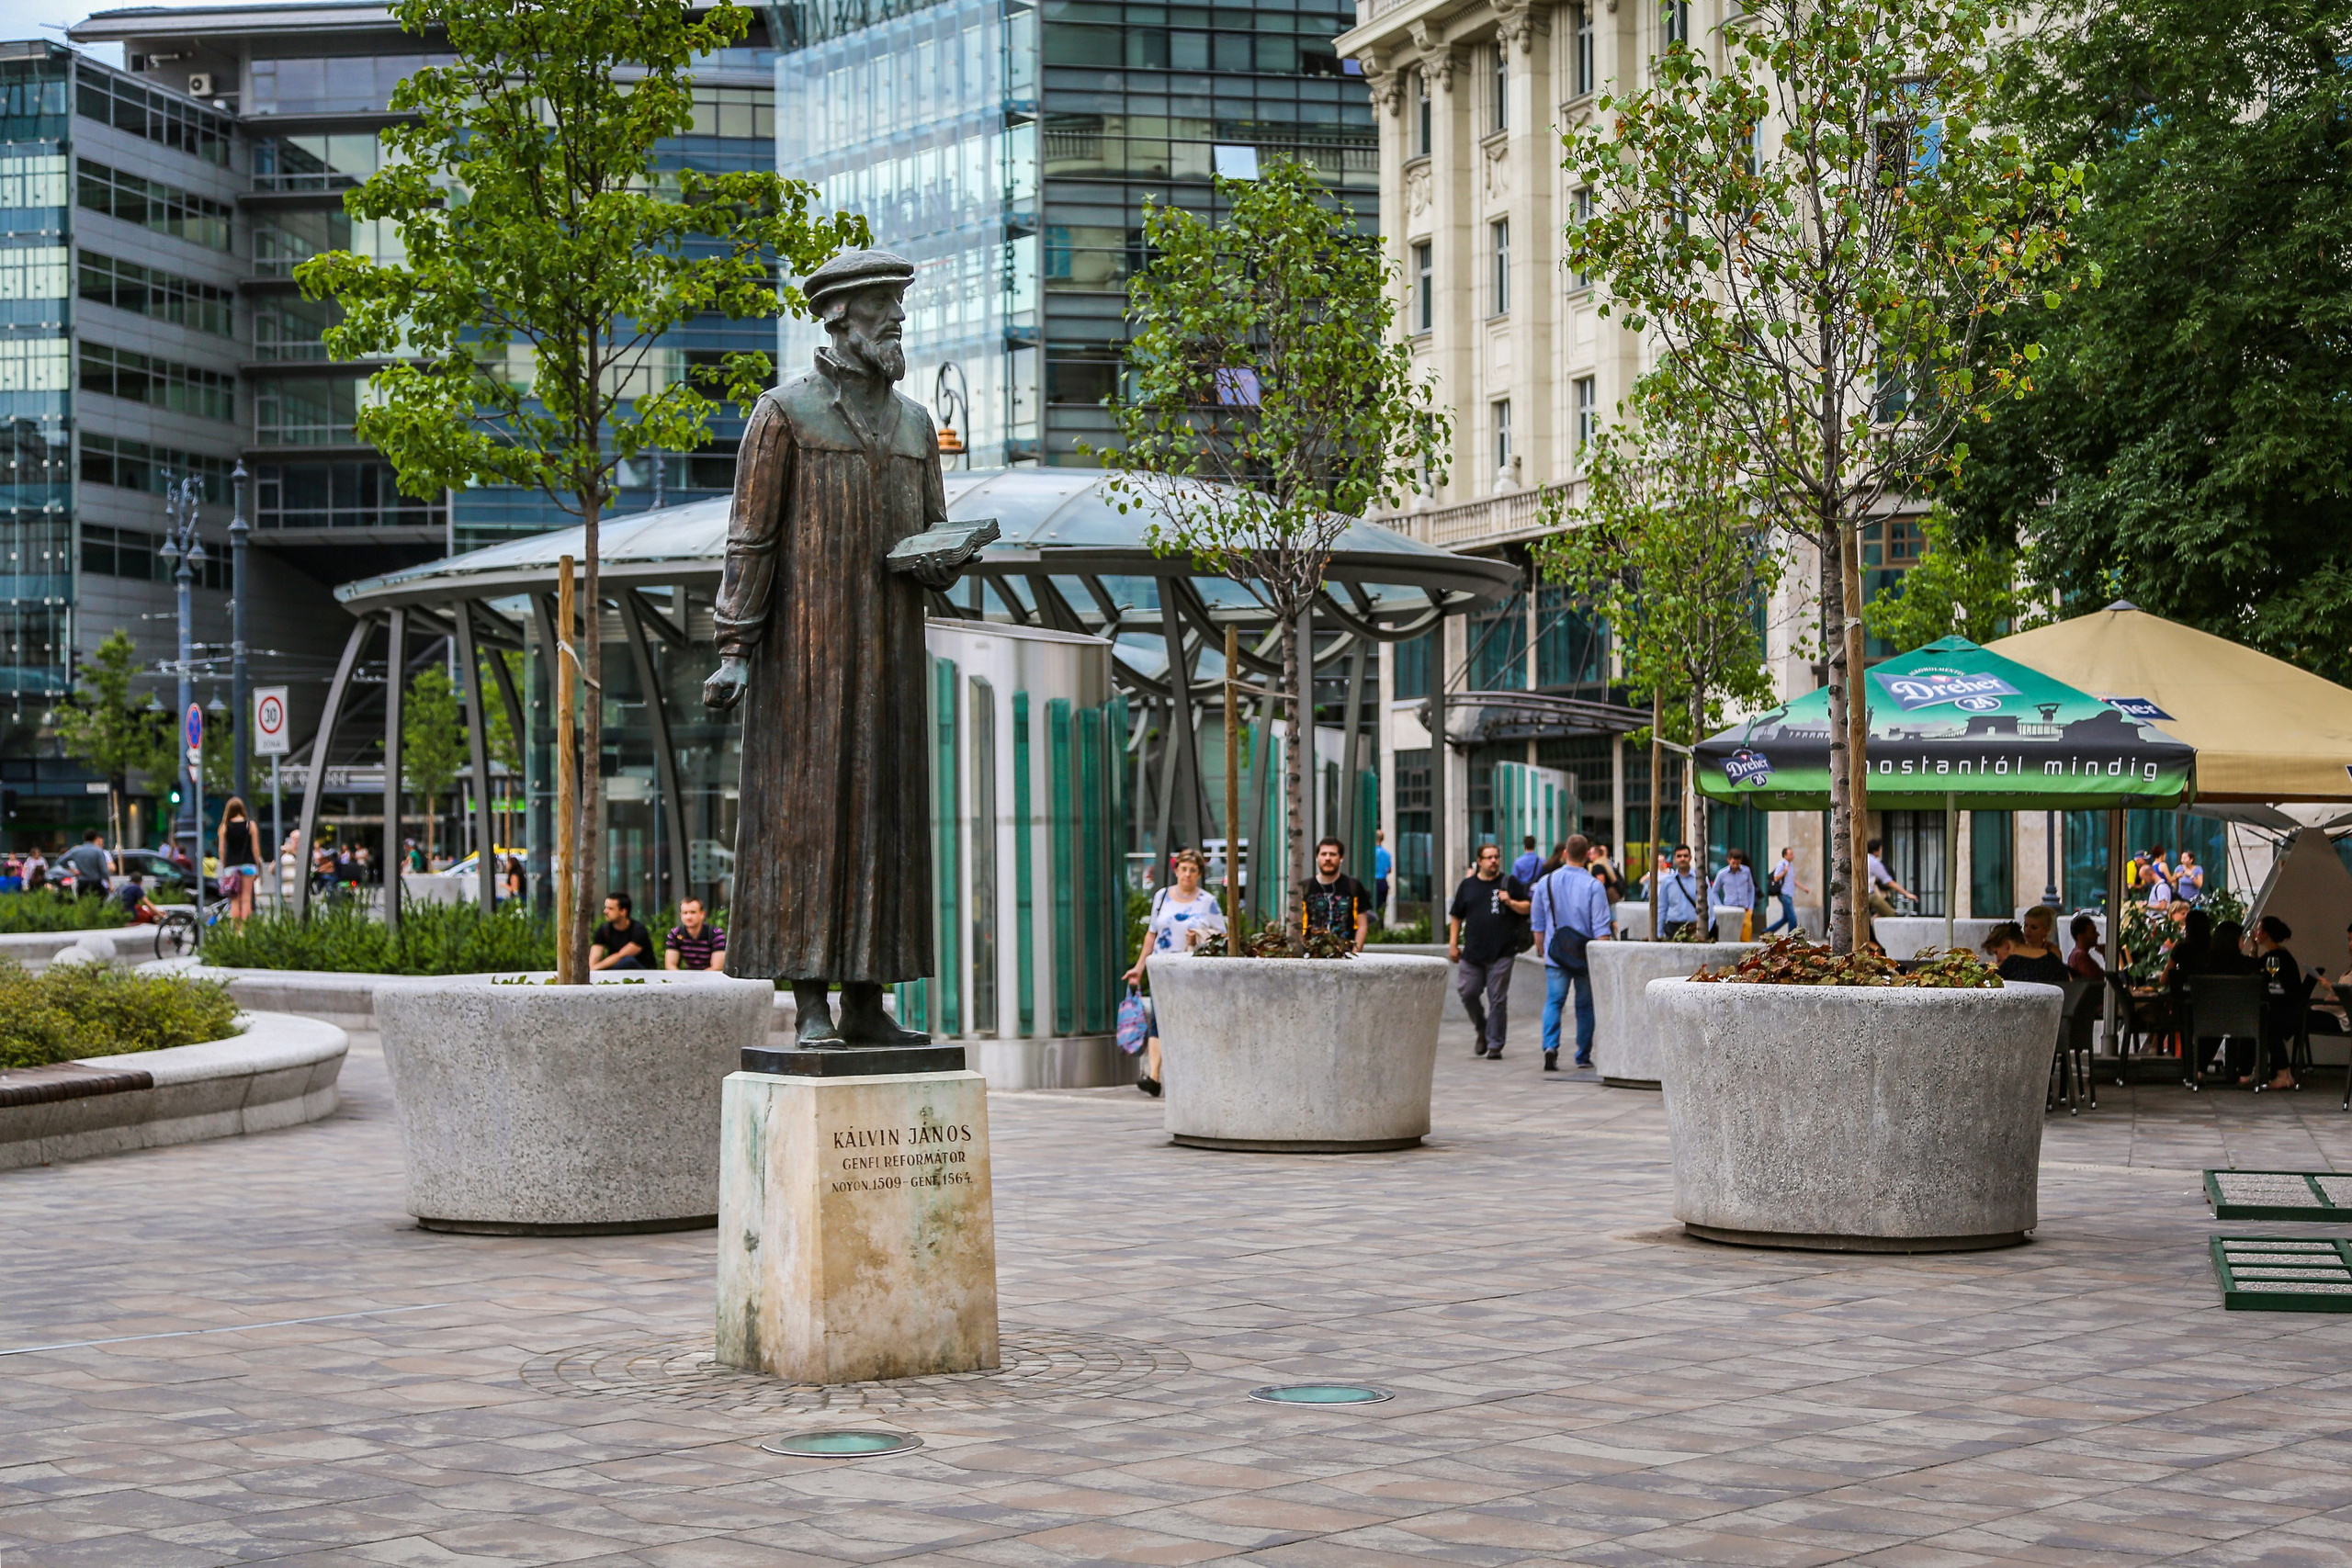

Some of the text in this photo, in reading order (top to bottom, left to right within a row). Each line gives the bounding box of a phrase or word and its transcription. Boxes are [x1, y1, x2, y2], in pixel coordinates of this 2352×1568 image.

[1890, 678, 2002, 702] Dreher
[1962, 695, 1996, 710] 24
[2110, 700, 2158, 715] her
[264, 706, 277, 723] 30
[1725, 757, 1770, 778] Dreher
[2042, 756, 2158, 783] mindig
[1753, 773, 1766, 785] 24
[833, 1121, 972, 1149] KÁLVIN JÁNOS
[842, 1149, 967, 1170] GENFI REFORMÁTOR
